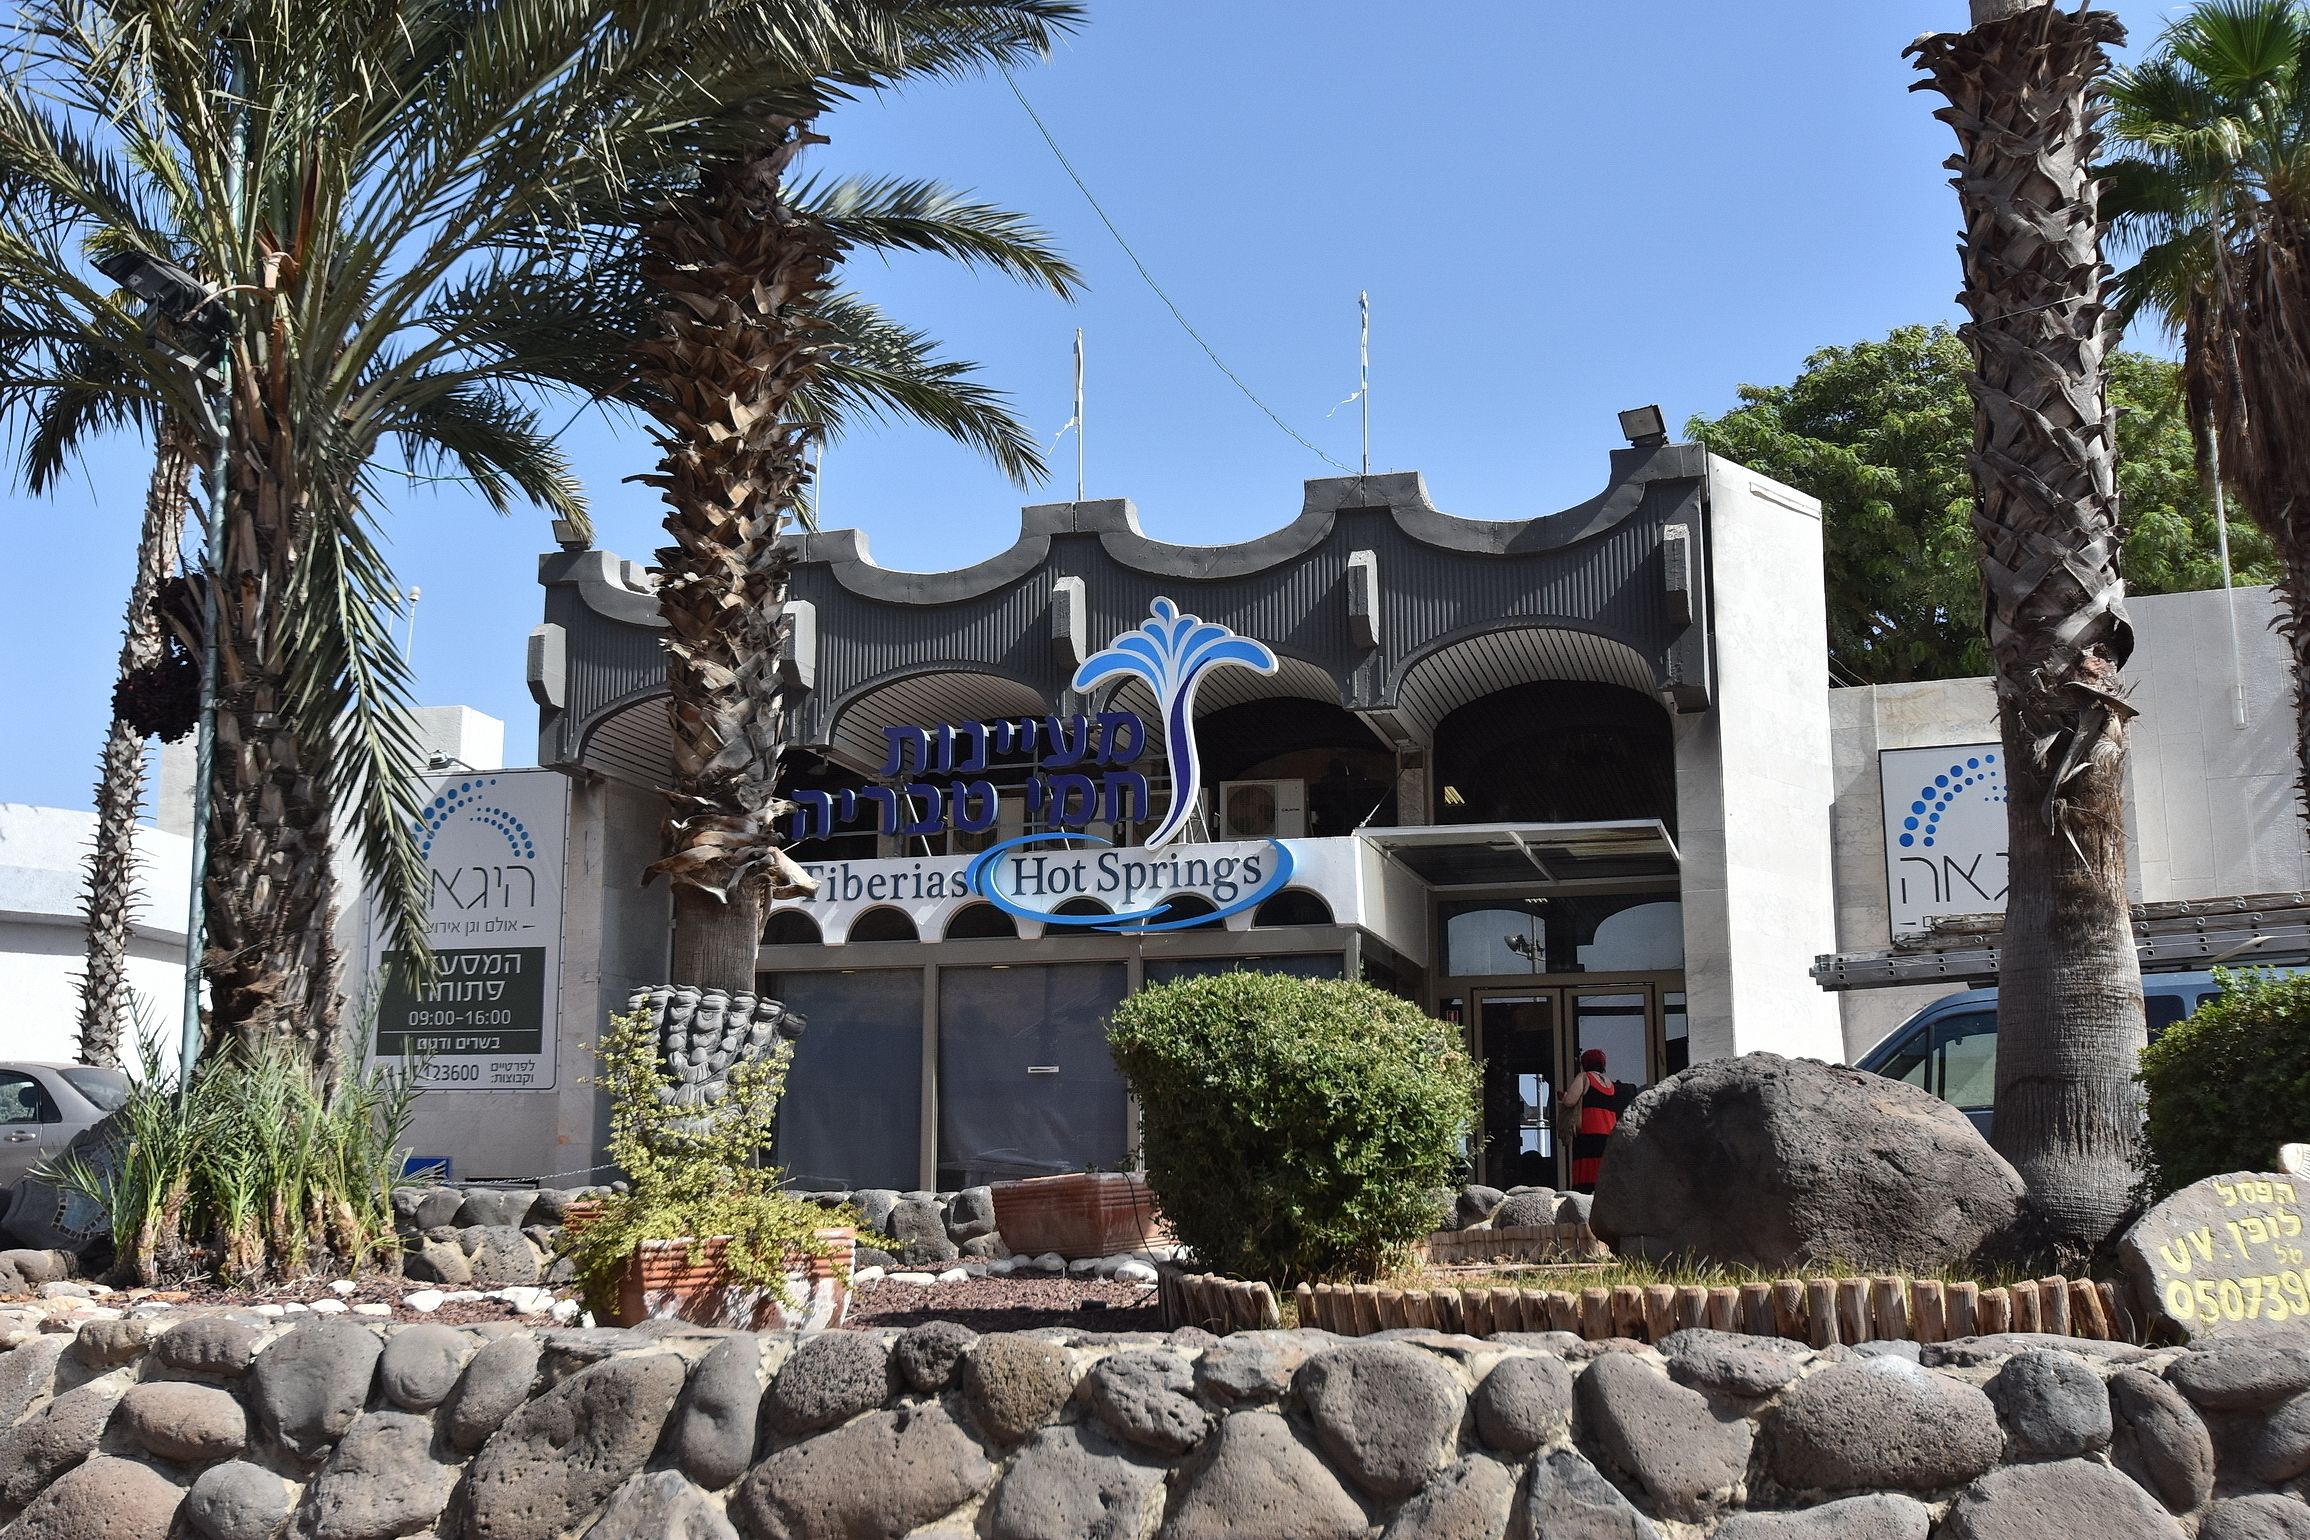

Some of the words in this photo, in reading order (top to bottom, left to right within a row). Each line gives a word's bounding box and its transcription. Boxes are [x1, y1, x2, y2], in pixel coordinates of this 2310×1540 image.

[880, 711, 1147, 778] מעיינות
[792, 780, 999, 841] טבריה
[1026, 771, 1149, 829] חמי
[420, 865, 536, 910] היגא
[1011, 856, 1087, 896] Hot
[1097, 852, 1263, 905] Springs
[465, 920, 481, 937] וגן
[485, 916, 519, 934] אולם
[432, 953, 522, 976] המסע
[408, 1009, 512, 1026] 09:00-16:00
[456, 1036, 500, 1050] בשרים
